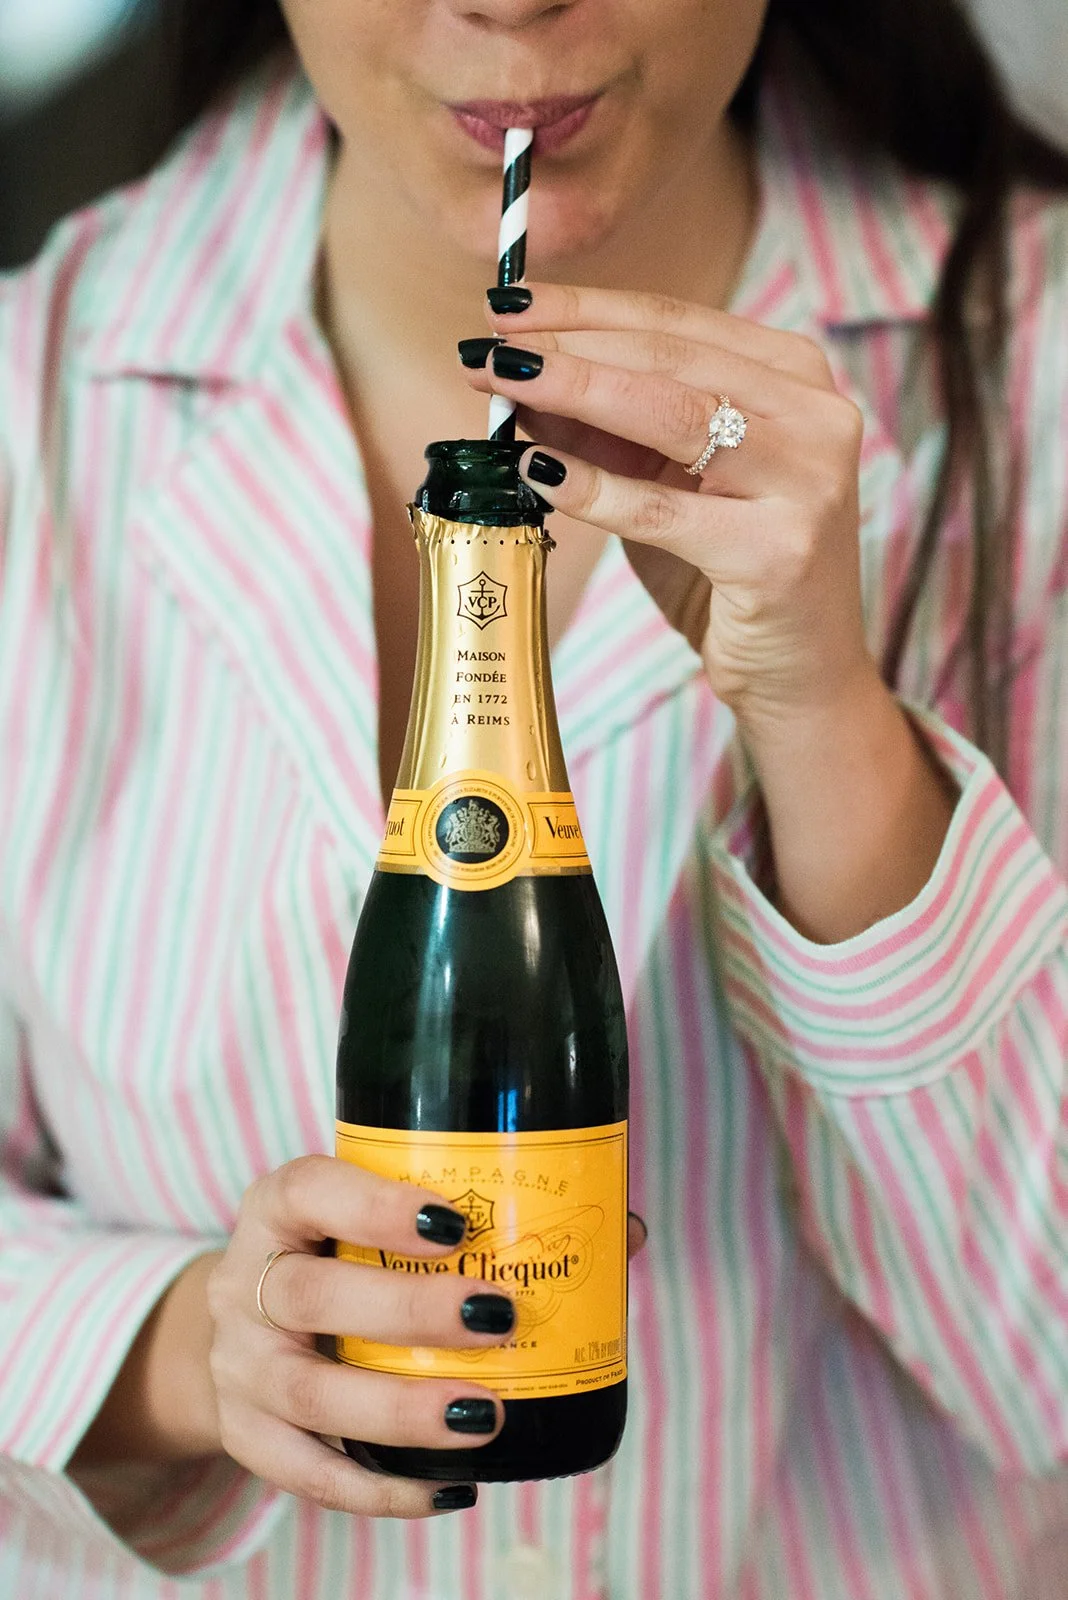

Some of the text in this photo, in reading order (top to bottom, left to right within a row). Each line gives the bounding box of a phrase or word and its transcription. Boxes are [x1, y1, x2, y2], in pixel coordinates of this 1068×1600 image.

[468, 596, 497, 609] VCP
[457, 649, 506, 662] MAISON
[456, 670, 507, 683] FONDÉE
[454, 694, 508, 705] EN 1772
[467, 714, 510, 726] REIMS
[543, 816, 580, 840] Veuve
[399, 1166, 570, 1193] HAMPAGNE
[489, 1340, 538, 1350] ANCE
[575, 1375, 602, 1386] PRODUCT
